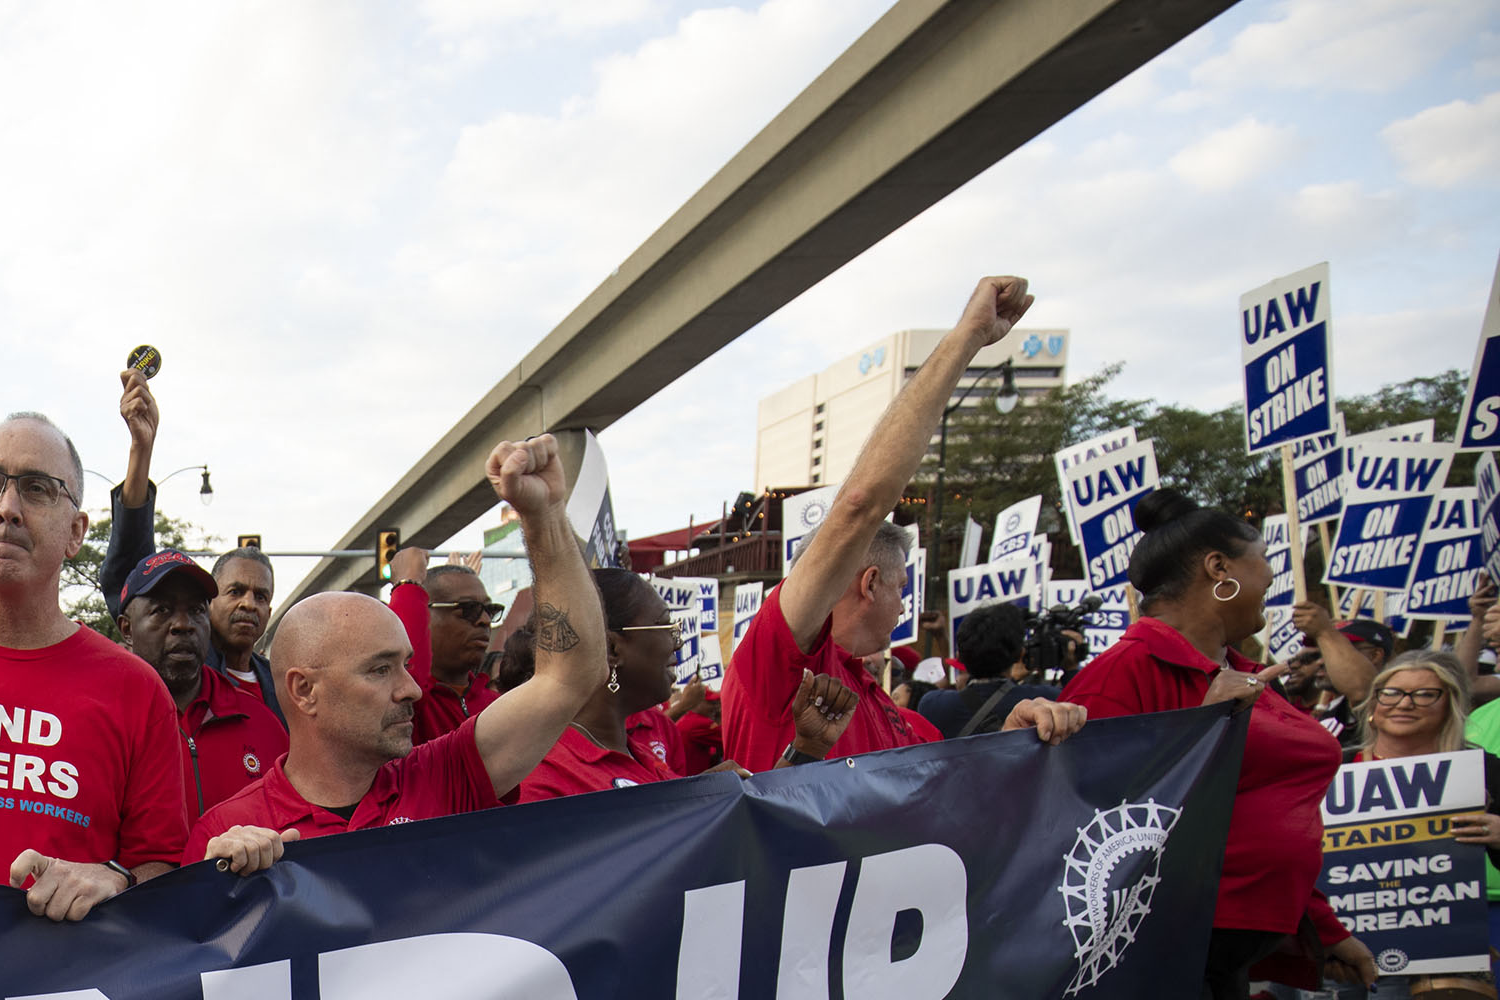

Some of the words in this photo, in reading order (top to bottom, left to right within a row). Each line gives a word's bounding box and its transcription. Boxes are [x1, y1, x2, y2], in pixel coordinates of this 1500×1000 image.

[1243, 281, 1321, 345] UAW
[136, 350, 156, 370] TRIKE!
[1266, 344, 1296, 394] ON
[1249, 366, 1325, 445] STRIKE
[1072, 455, 1146, 507] UAW
[1307, 459, 1328, 489] ON
[1357, 457, 1444, 492] UAW
[1102, 504, 1134, 545] ON
[1361, 504, 1400, 540] ON
[1331, 534, 1417, 577] STRIKE
[1435, 540, 1471, 575] ON
[736, 591, 759, 613] UAW
[954, 568, 1027, 604] UAW
[681, 616, 698, 634] AW
[1325, 760, 1452, 816] UAW
[19, 800, 91, 828] WORKERS
[1103, 834, 1135, 861] AMERICA
[1137, 832, 1165, 845] UNITED
[1322, 824, 1416, 849] TAND
[1428, 819, 1450, 836] U
[1093, 858, 1105, 871] OF
[1328, 854, 1452, 884] SAVING
[1091, 870, 1100, 917] WORKERS
[1329, 880, 1480, 913] MERICAN
[1378, 880, 1401, 888] THE
